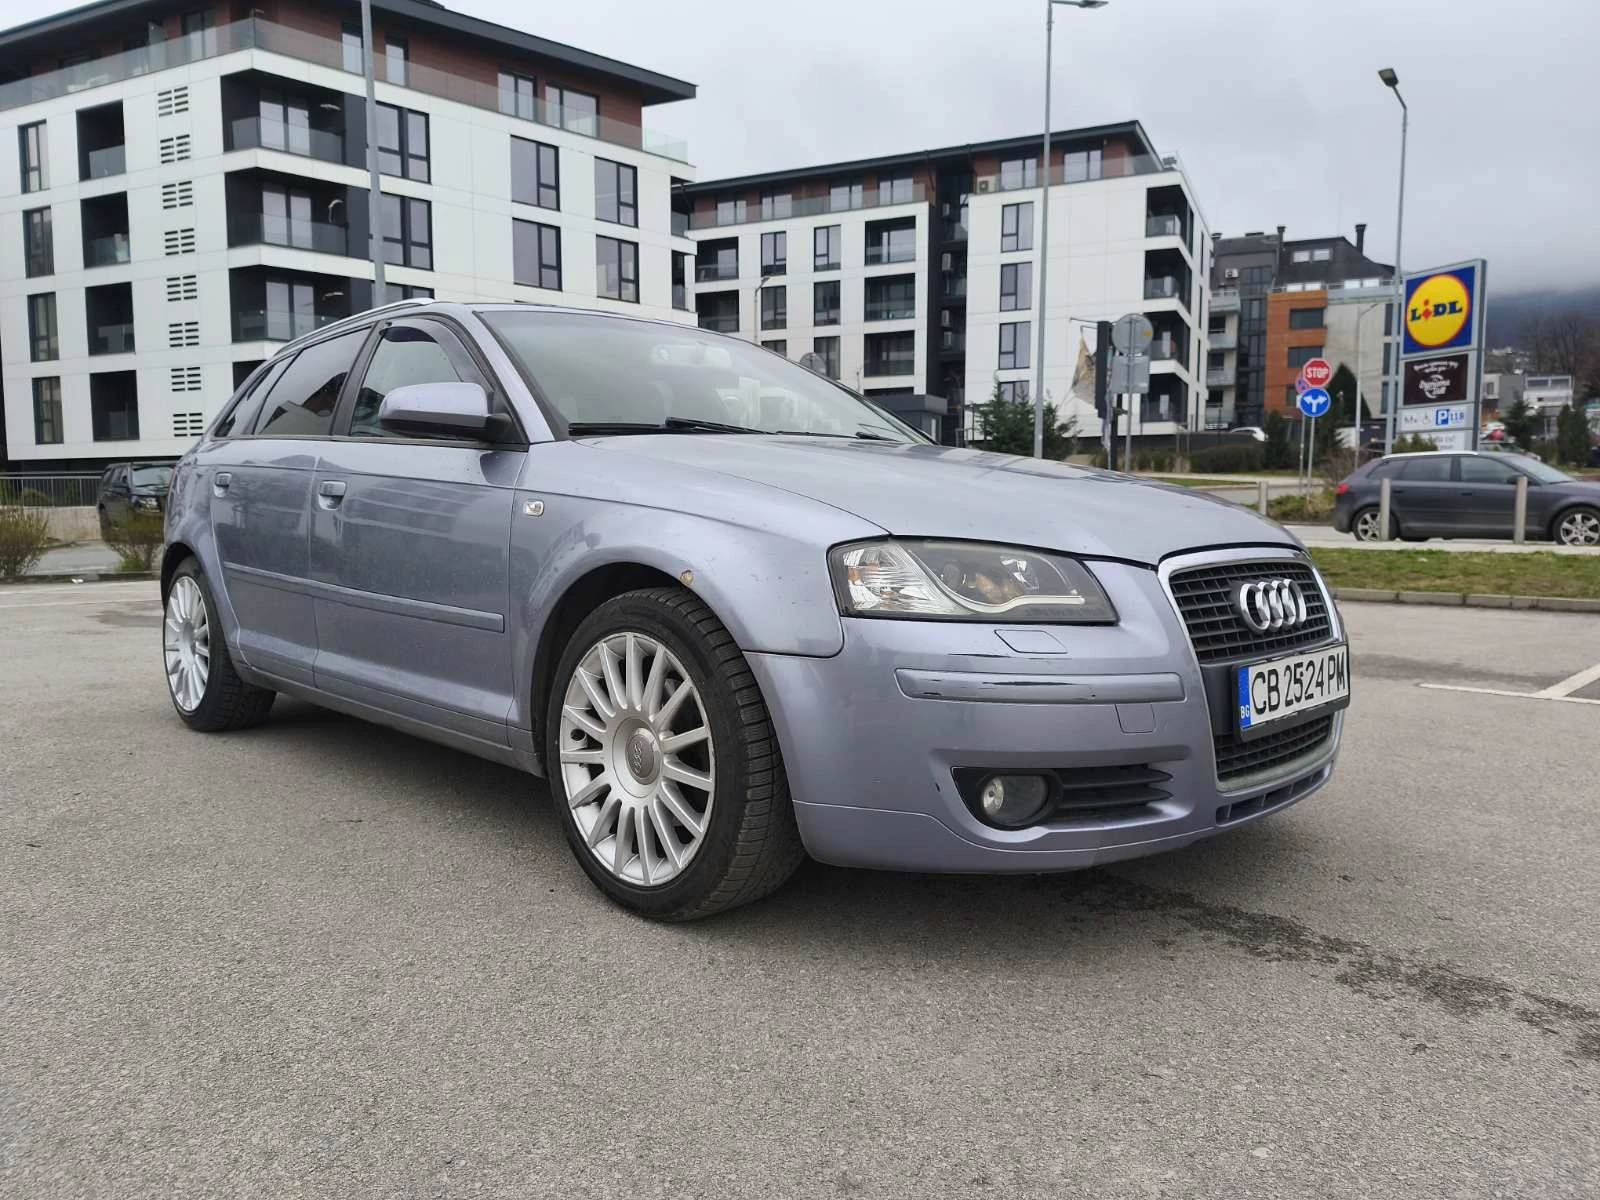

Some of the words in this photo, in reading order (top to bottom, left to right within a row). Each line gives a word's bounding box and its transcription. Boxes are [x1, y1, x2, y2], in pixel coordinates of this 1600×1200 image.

[1306, 366, 1329, 379] STOP
[1251, 669, 1280, 716] CB
[1284, 660, 1325, 708] 2524
[1327, 650, 1346, 696] PM
[1240, 704, 1250, 719] BG
